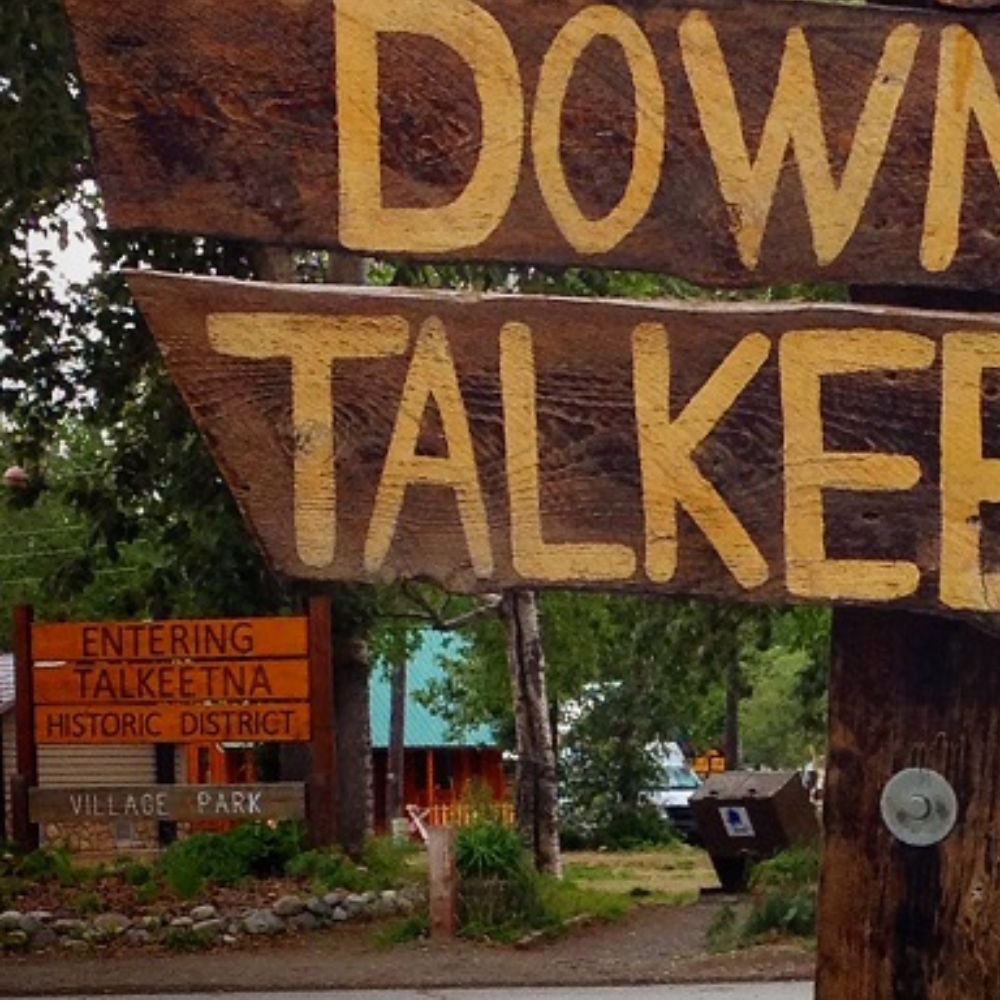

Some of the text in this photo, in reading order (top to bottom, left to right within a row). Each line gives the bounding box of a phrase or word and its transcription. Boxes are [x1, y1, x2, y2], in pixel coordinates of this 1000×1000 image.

[82, 622, 254, 658] ENTERING
[74, 663, 272, 699] TALKEETNA
[47, 709, 296, 738] HISTORIC DISTRICT
[69, 791, 262, 816] VILLAGE PARK
